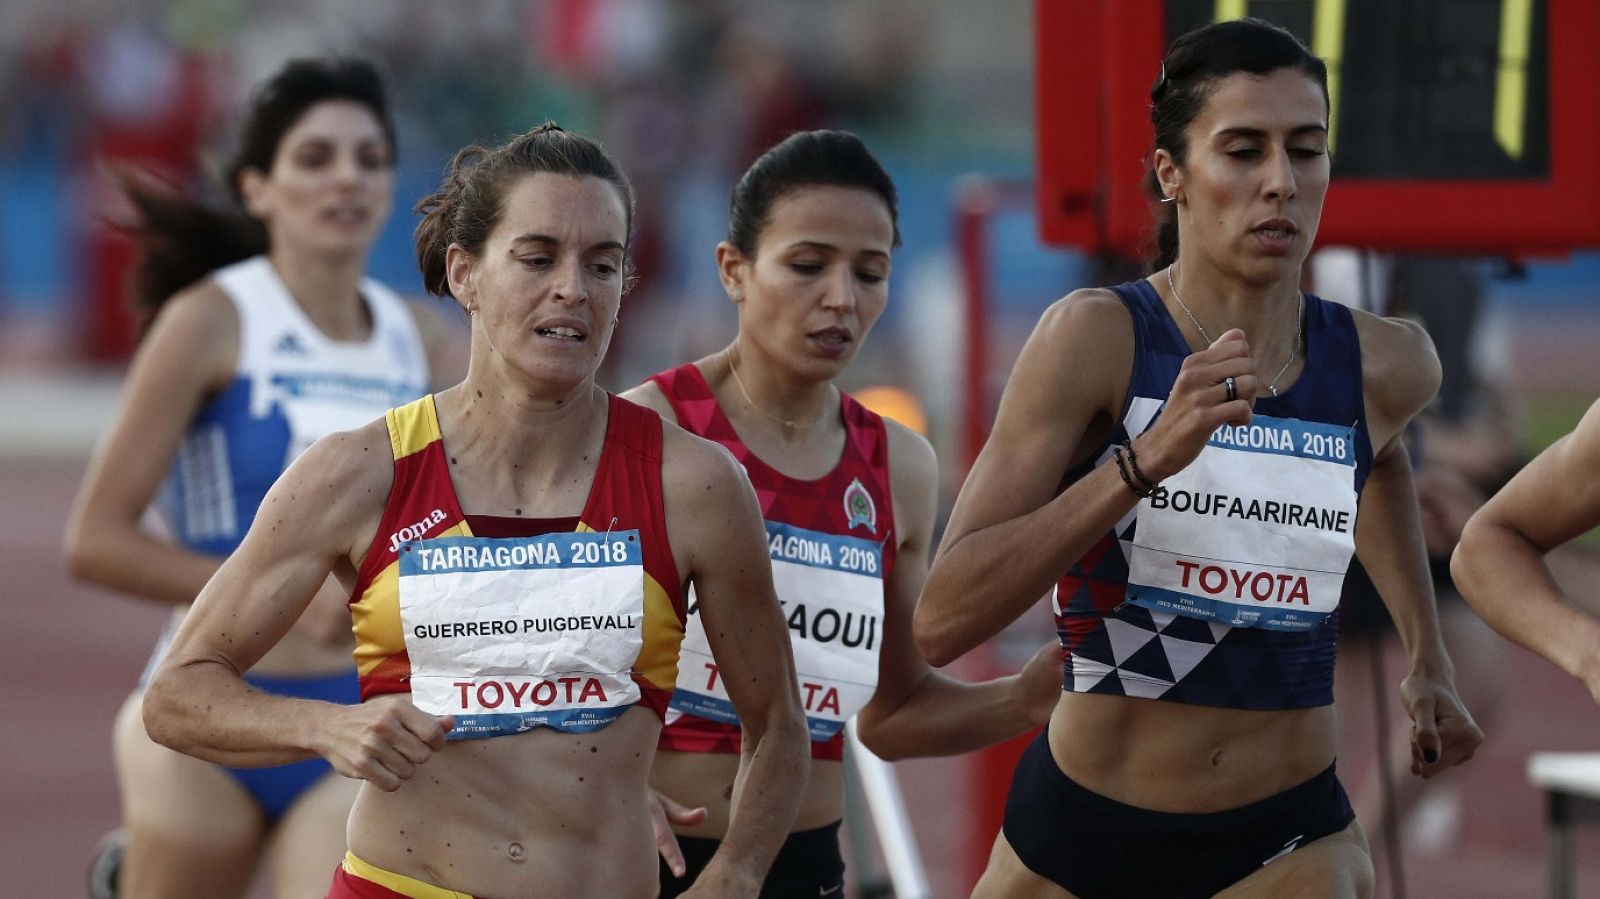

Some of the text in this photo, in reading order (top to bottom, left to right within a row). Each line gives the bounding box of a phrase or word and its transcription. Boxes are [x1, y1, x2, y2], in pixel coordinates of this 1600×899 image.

[1209, 424, 1346, 460] RAGONA 2018
[1150, 486, 1350, 533] BOUFAARIRANE
[388, 508, 447, 552] Joma
[418, 541, 628, 571] TARRAGONA 2018
[768, 533, 877, 573] AGONA 2018
[1176, 560, 1310, 606] TOYOTA
[414, 615, 636, 639] GUERRERO PUIGDEVALL
[453, 677, 608, 709] TOYOTA
